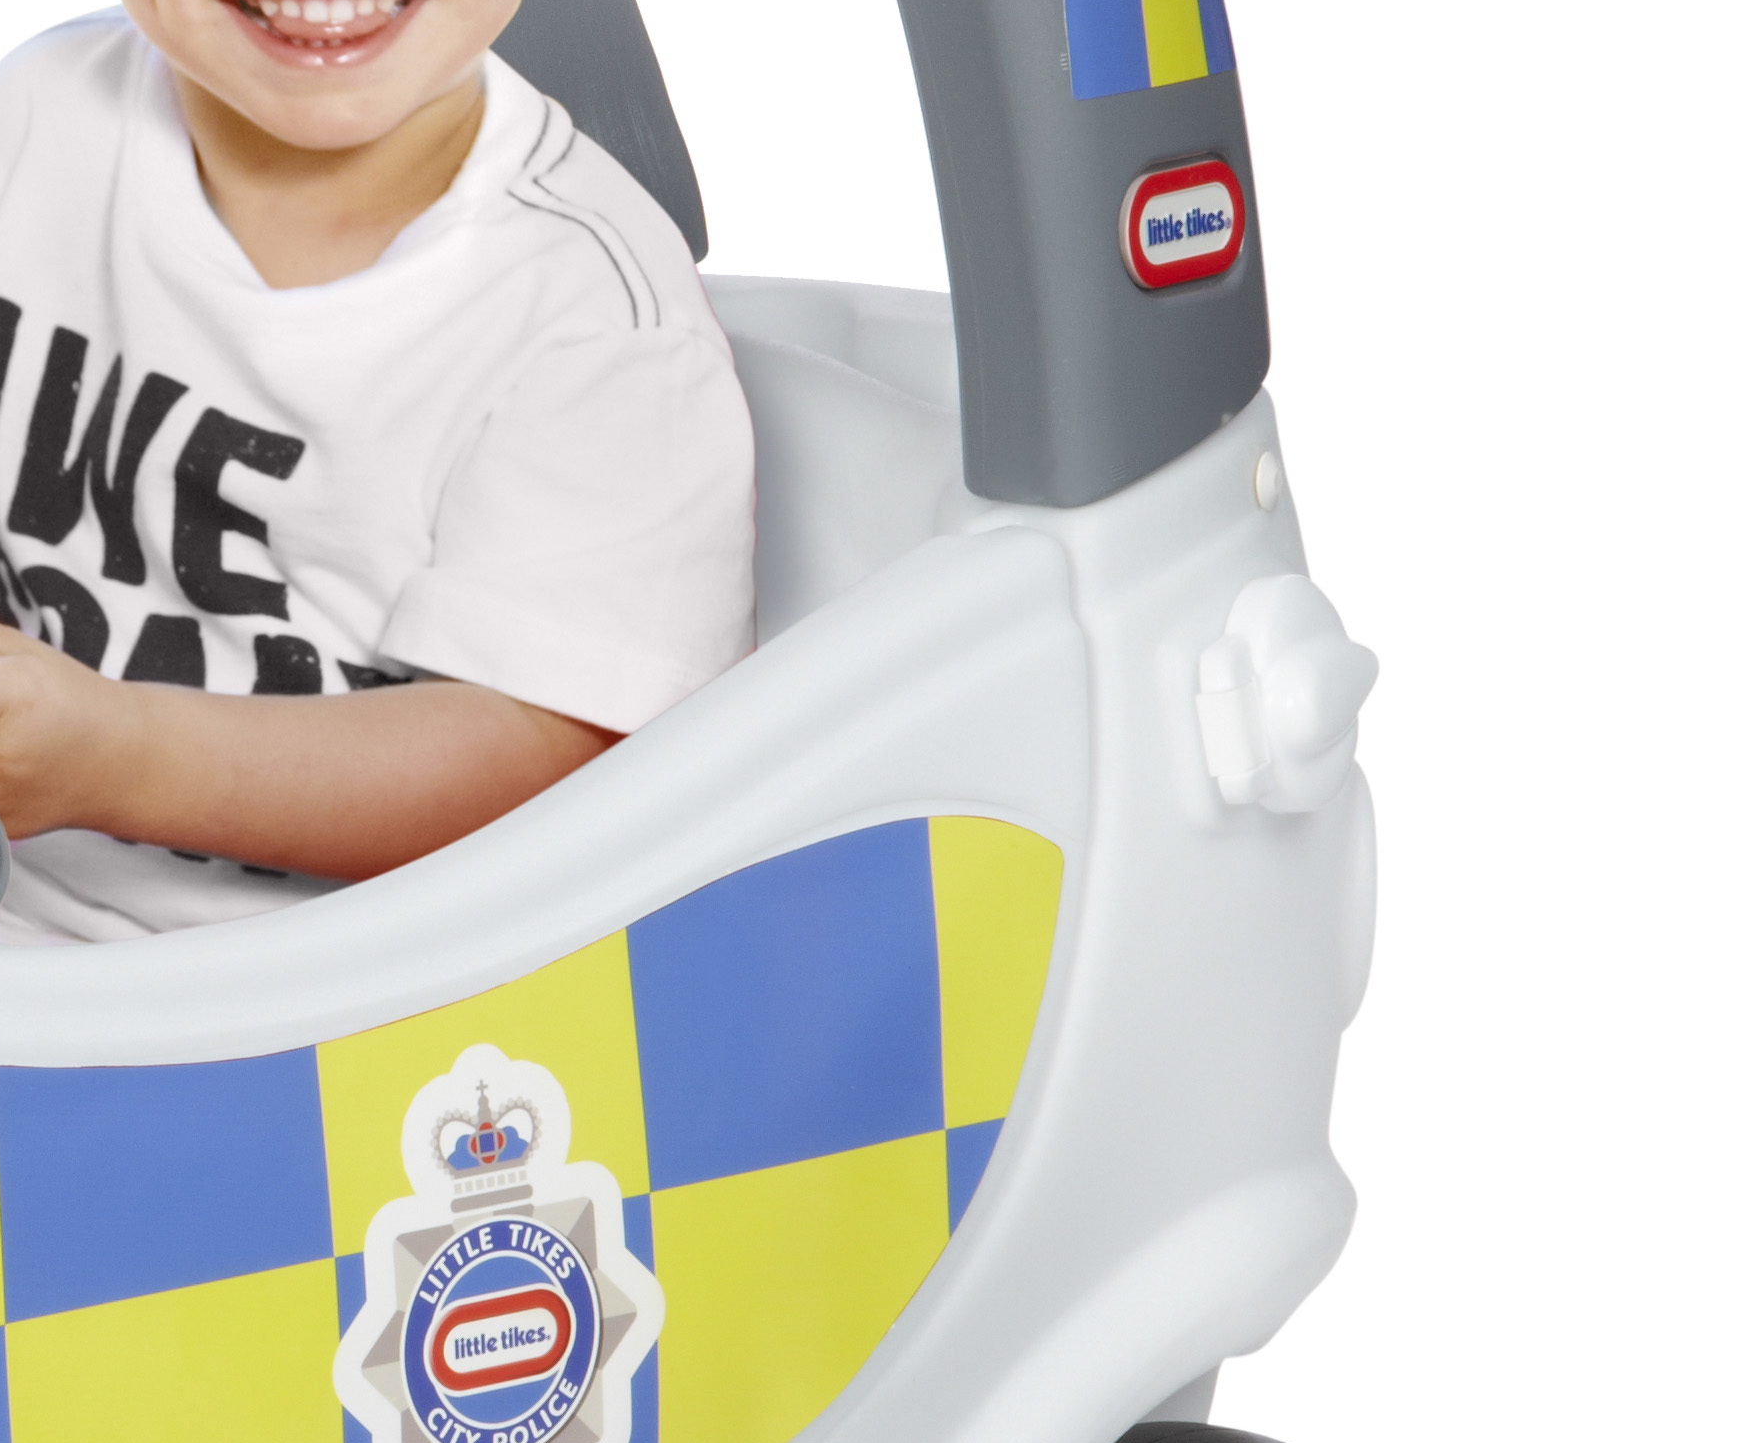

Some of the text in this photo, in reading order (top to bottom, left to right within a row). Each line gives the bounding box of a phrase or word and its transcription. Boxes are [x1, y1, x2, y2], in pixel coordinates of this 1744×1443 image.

[1147, 213, 1184, 247] little
[418, 1223, 576, 1305] LITTLE TIKES
[454, 1333, 498, 1360] little
